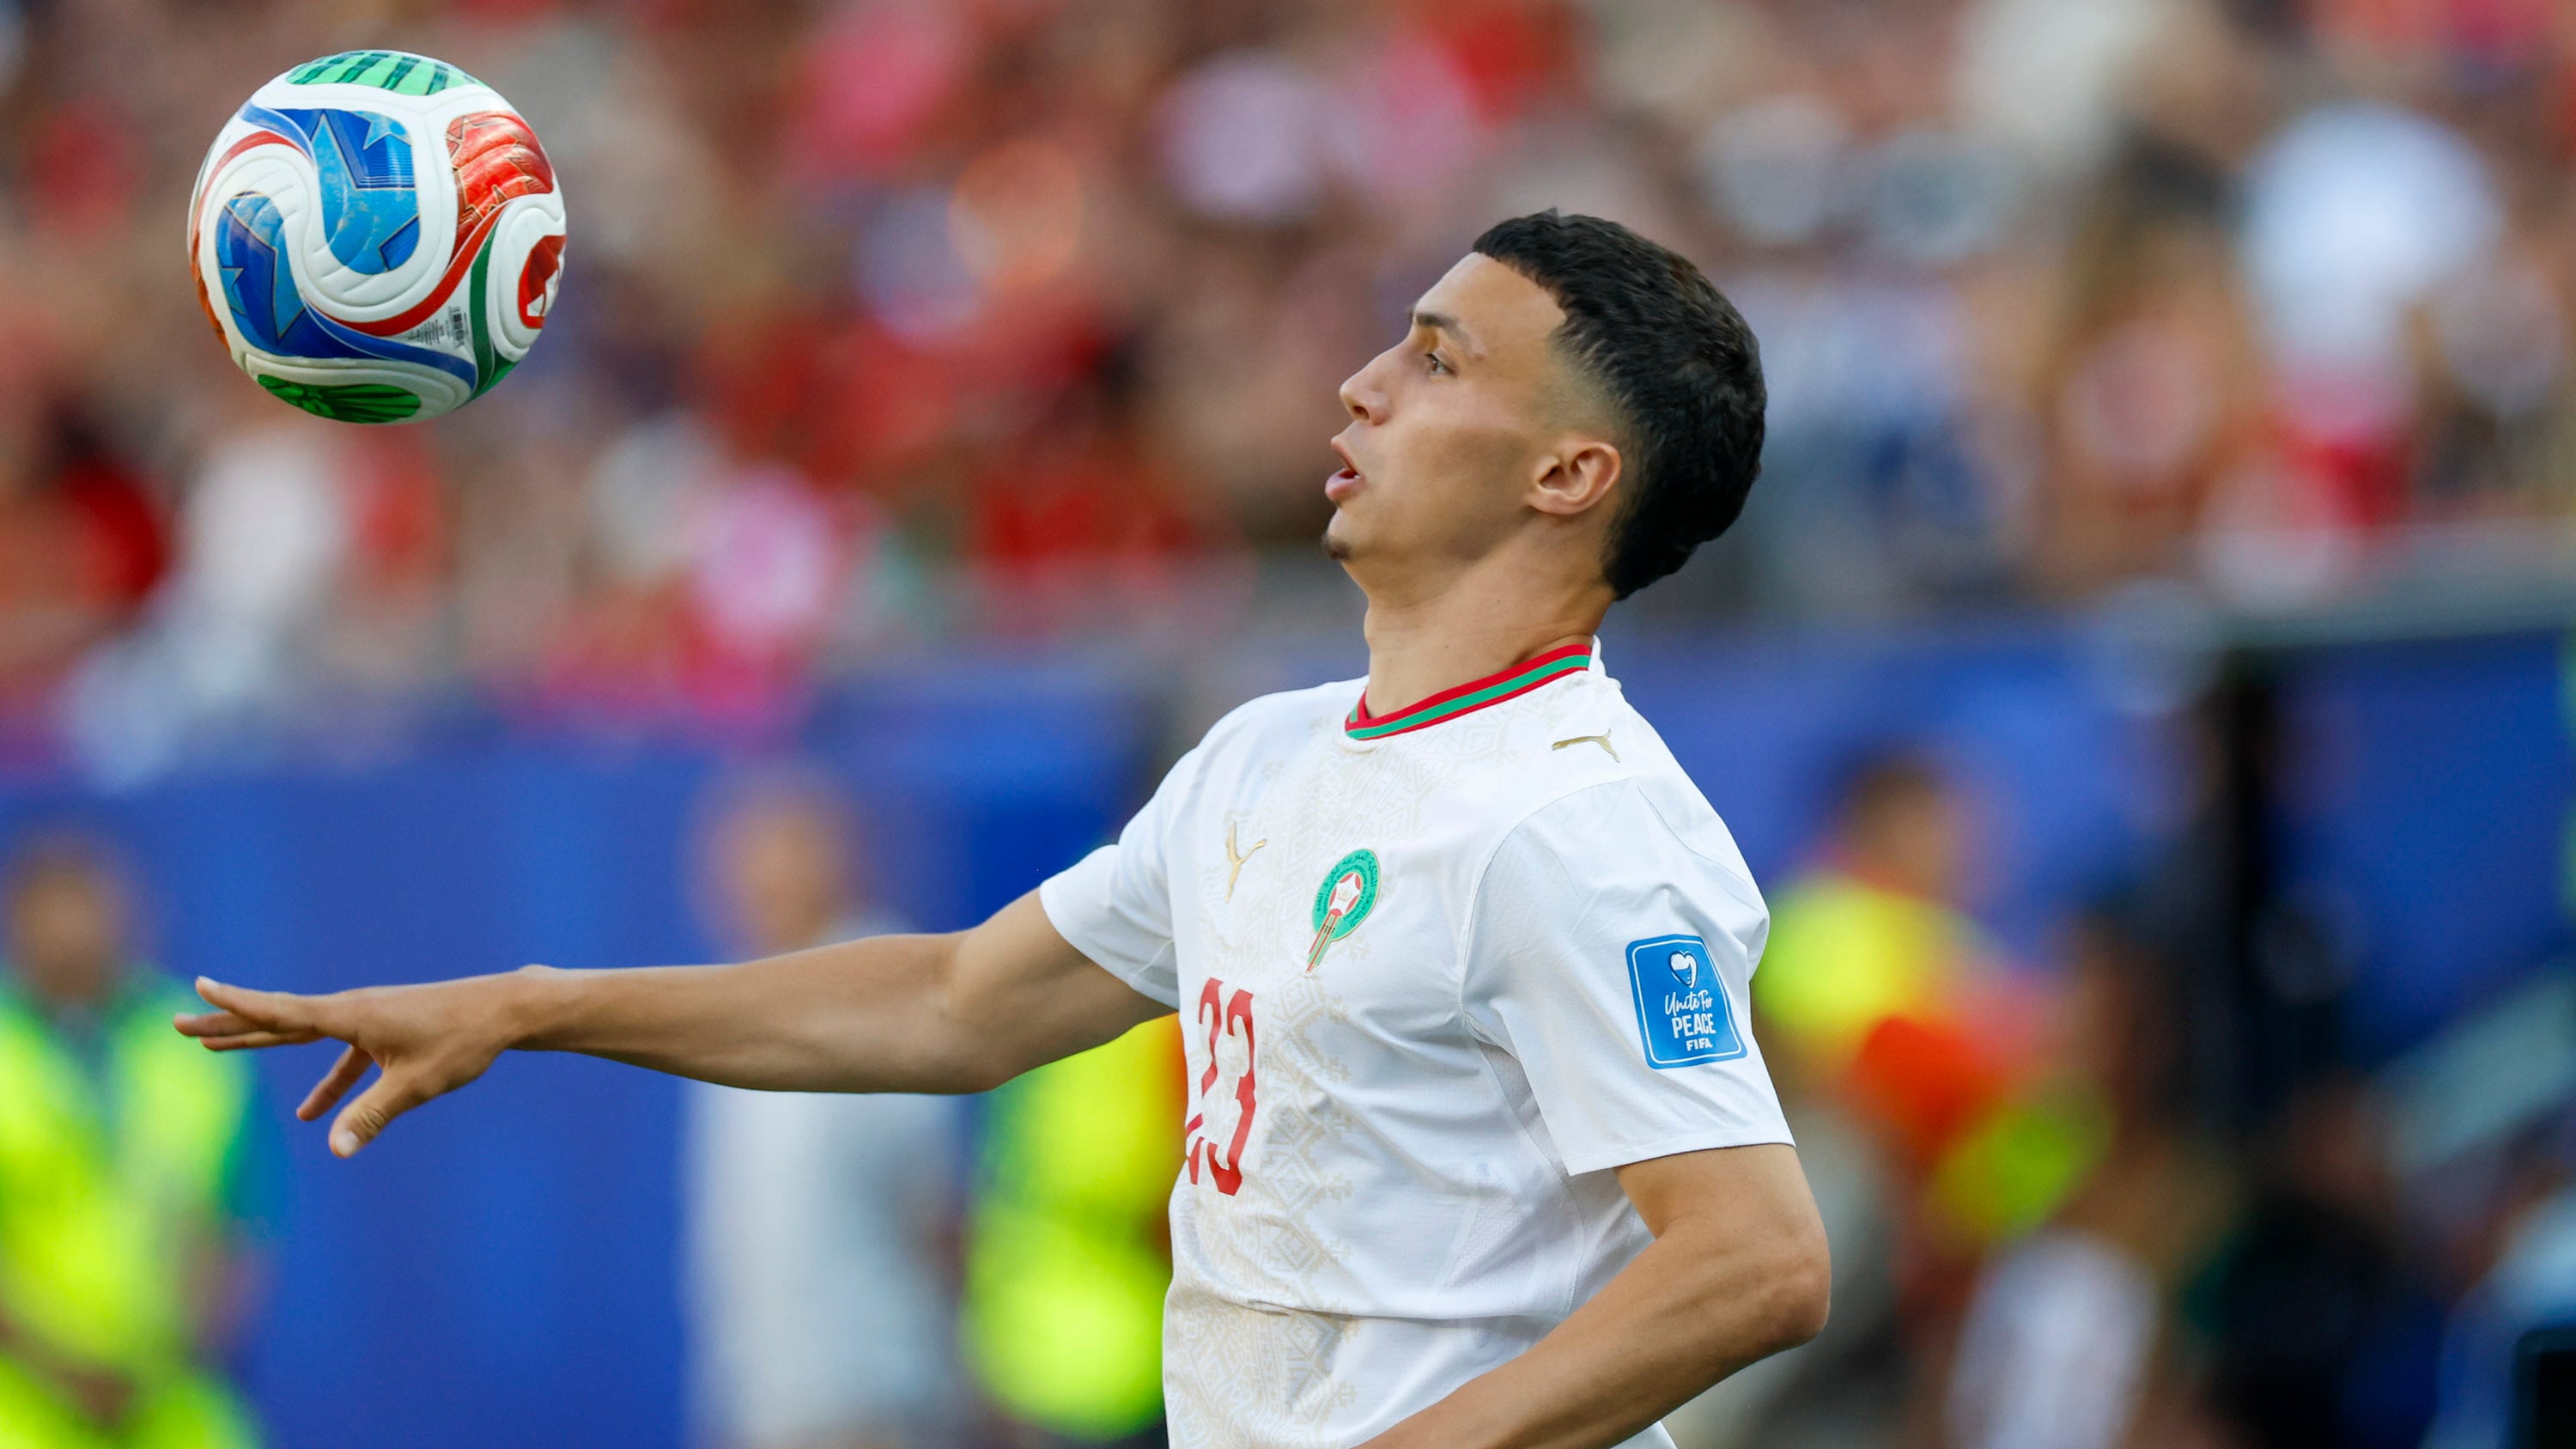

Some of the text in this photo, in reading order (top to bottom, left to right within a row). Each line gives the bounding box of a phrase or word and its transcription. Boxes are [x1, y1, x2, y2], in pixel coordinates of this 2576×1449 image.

[1665, 989, 1713, 1017] Unite For
[1671, 1013, 1716, 1038] PEACE
[1686, 1038, 1713, 1051] FIFA
[1186, 977, 1256, 1196] 23
